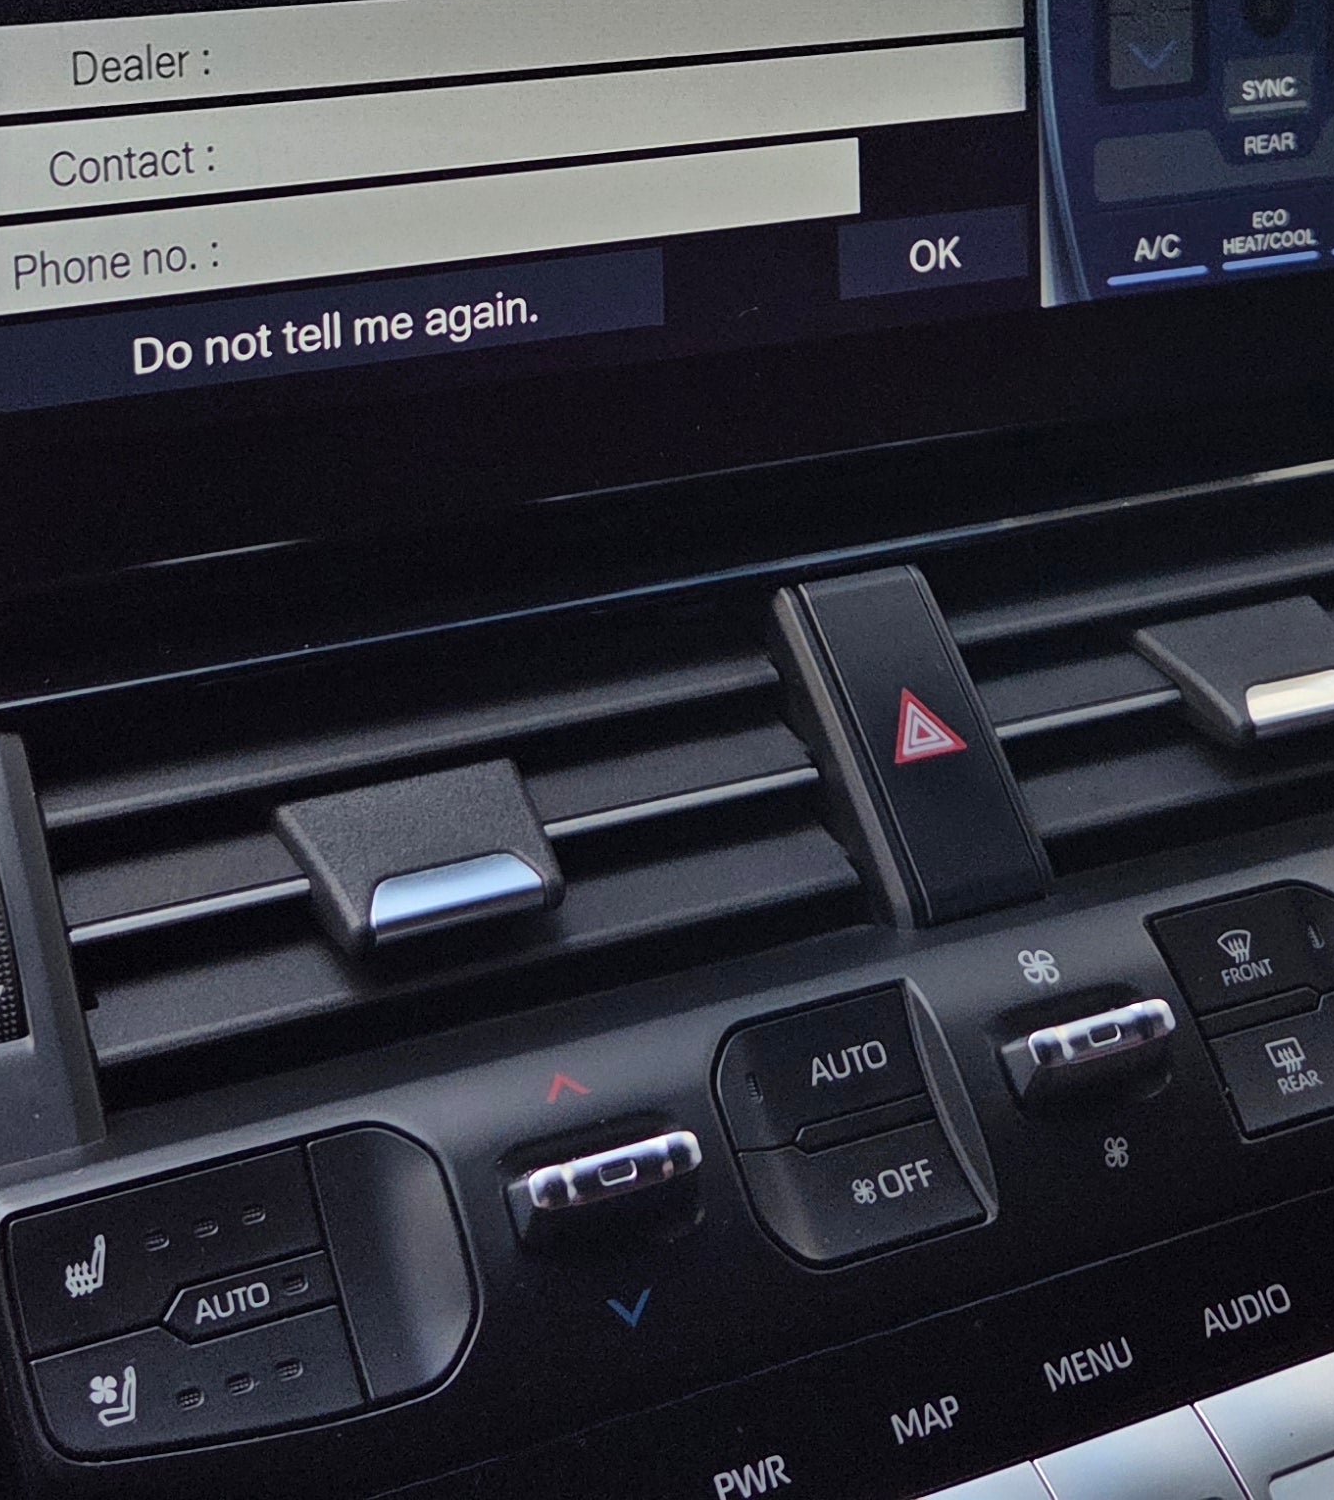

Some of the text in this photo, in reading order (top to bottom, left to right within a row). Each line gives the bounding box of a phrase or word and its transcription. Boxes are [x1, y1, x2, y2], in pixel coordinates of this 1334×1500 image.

[71, 44, 191, 86] Dealer
[1241, 77, 1296, 100] SYNC
[48, 141, 196, 187] Contact
[1244, 133, 1295, 155] REAR
[1252, 209, 1287, 227] ECO
[908, 237, 962, 274] OK
[1134, 234, 1181, 261] A/C
[1222, 230, 1317, 256] HEAT/COOL
[13, 251, 132, 291] Phone
[141, 242, 198, 277] no.
[133, 292, 539, 377] Do not tell me again.
[1222, 956, 1274, 987] FRONT
[810, 1038, 889, 1087] AUTO
[1278, 1067, 1324, 1095] REAR
[877, 1158, 936, 1201] OFF
[193, 1280, 271, 1325] AUTO
[1202, 1282, 1292, 1339] AUDIO
[1043, 1336, 1134, 1393] MENU
[890, 1394, 961, 1445] MAP
[713, 1452, 792, 1500] PWR
